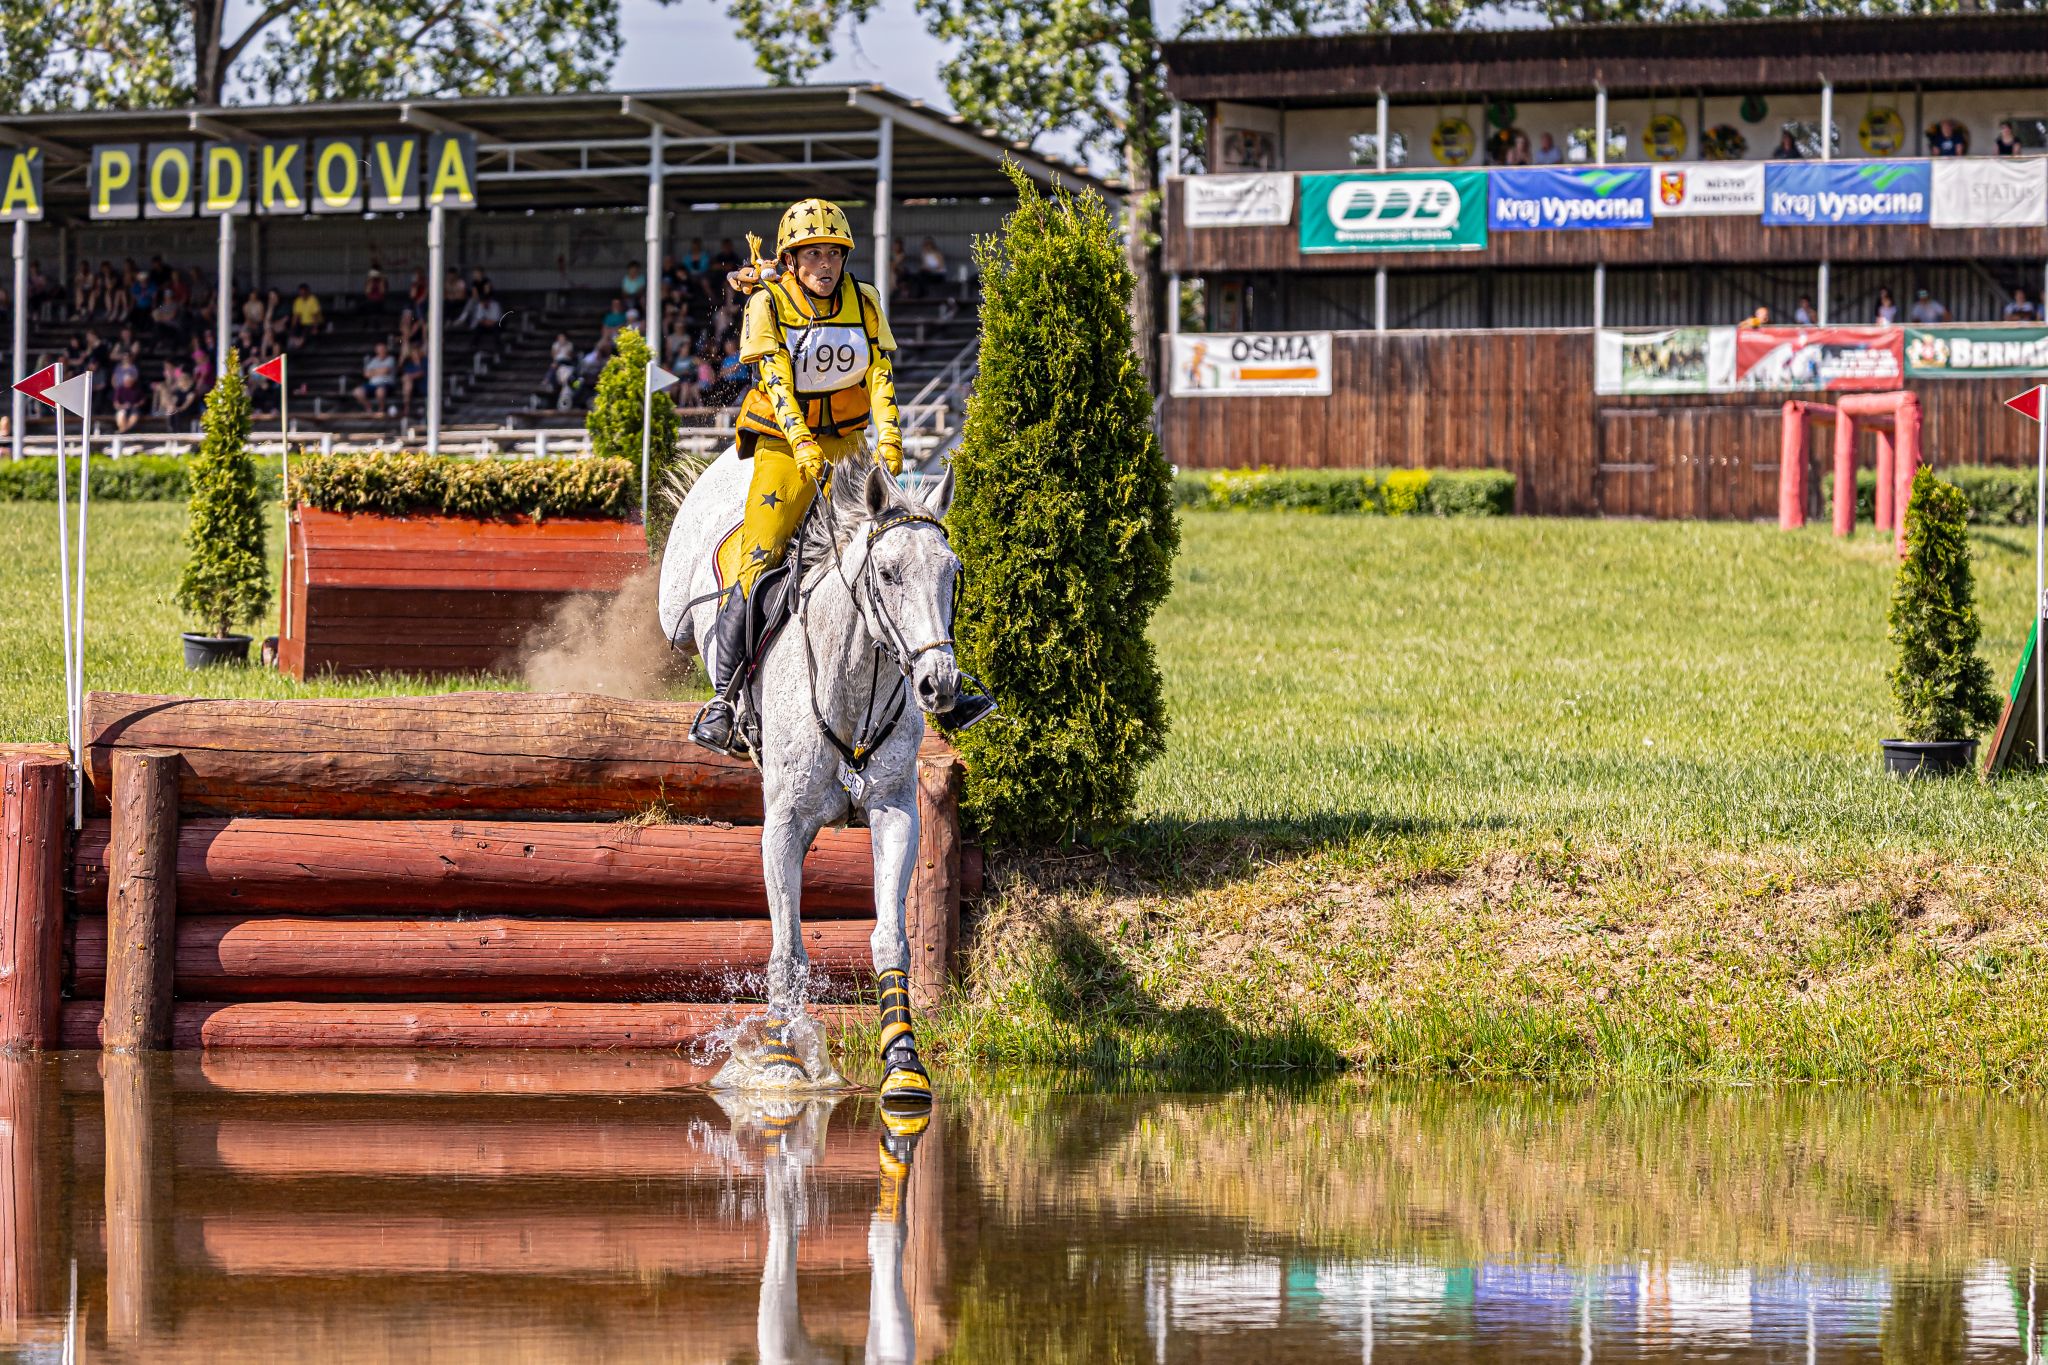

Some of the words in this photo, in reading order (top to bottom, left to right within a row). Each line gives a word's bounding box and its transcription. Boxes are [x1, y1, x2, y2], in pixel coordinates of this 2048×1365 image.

[98, 138, 474, 213] PODKOVA
[1496, 197, 1540, 227] Kraj
[1772, 192, 1815, 221] Kraj
[801, 344, 855, 373] 199
[1231, 337, 1315, 361] OSMA
